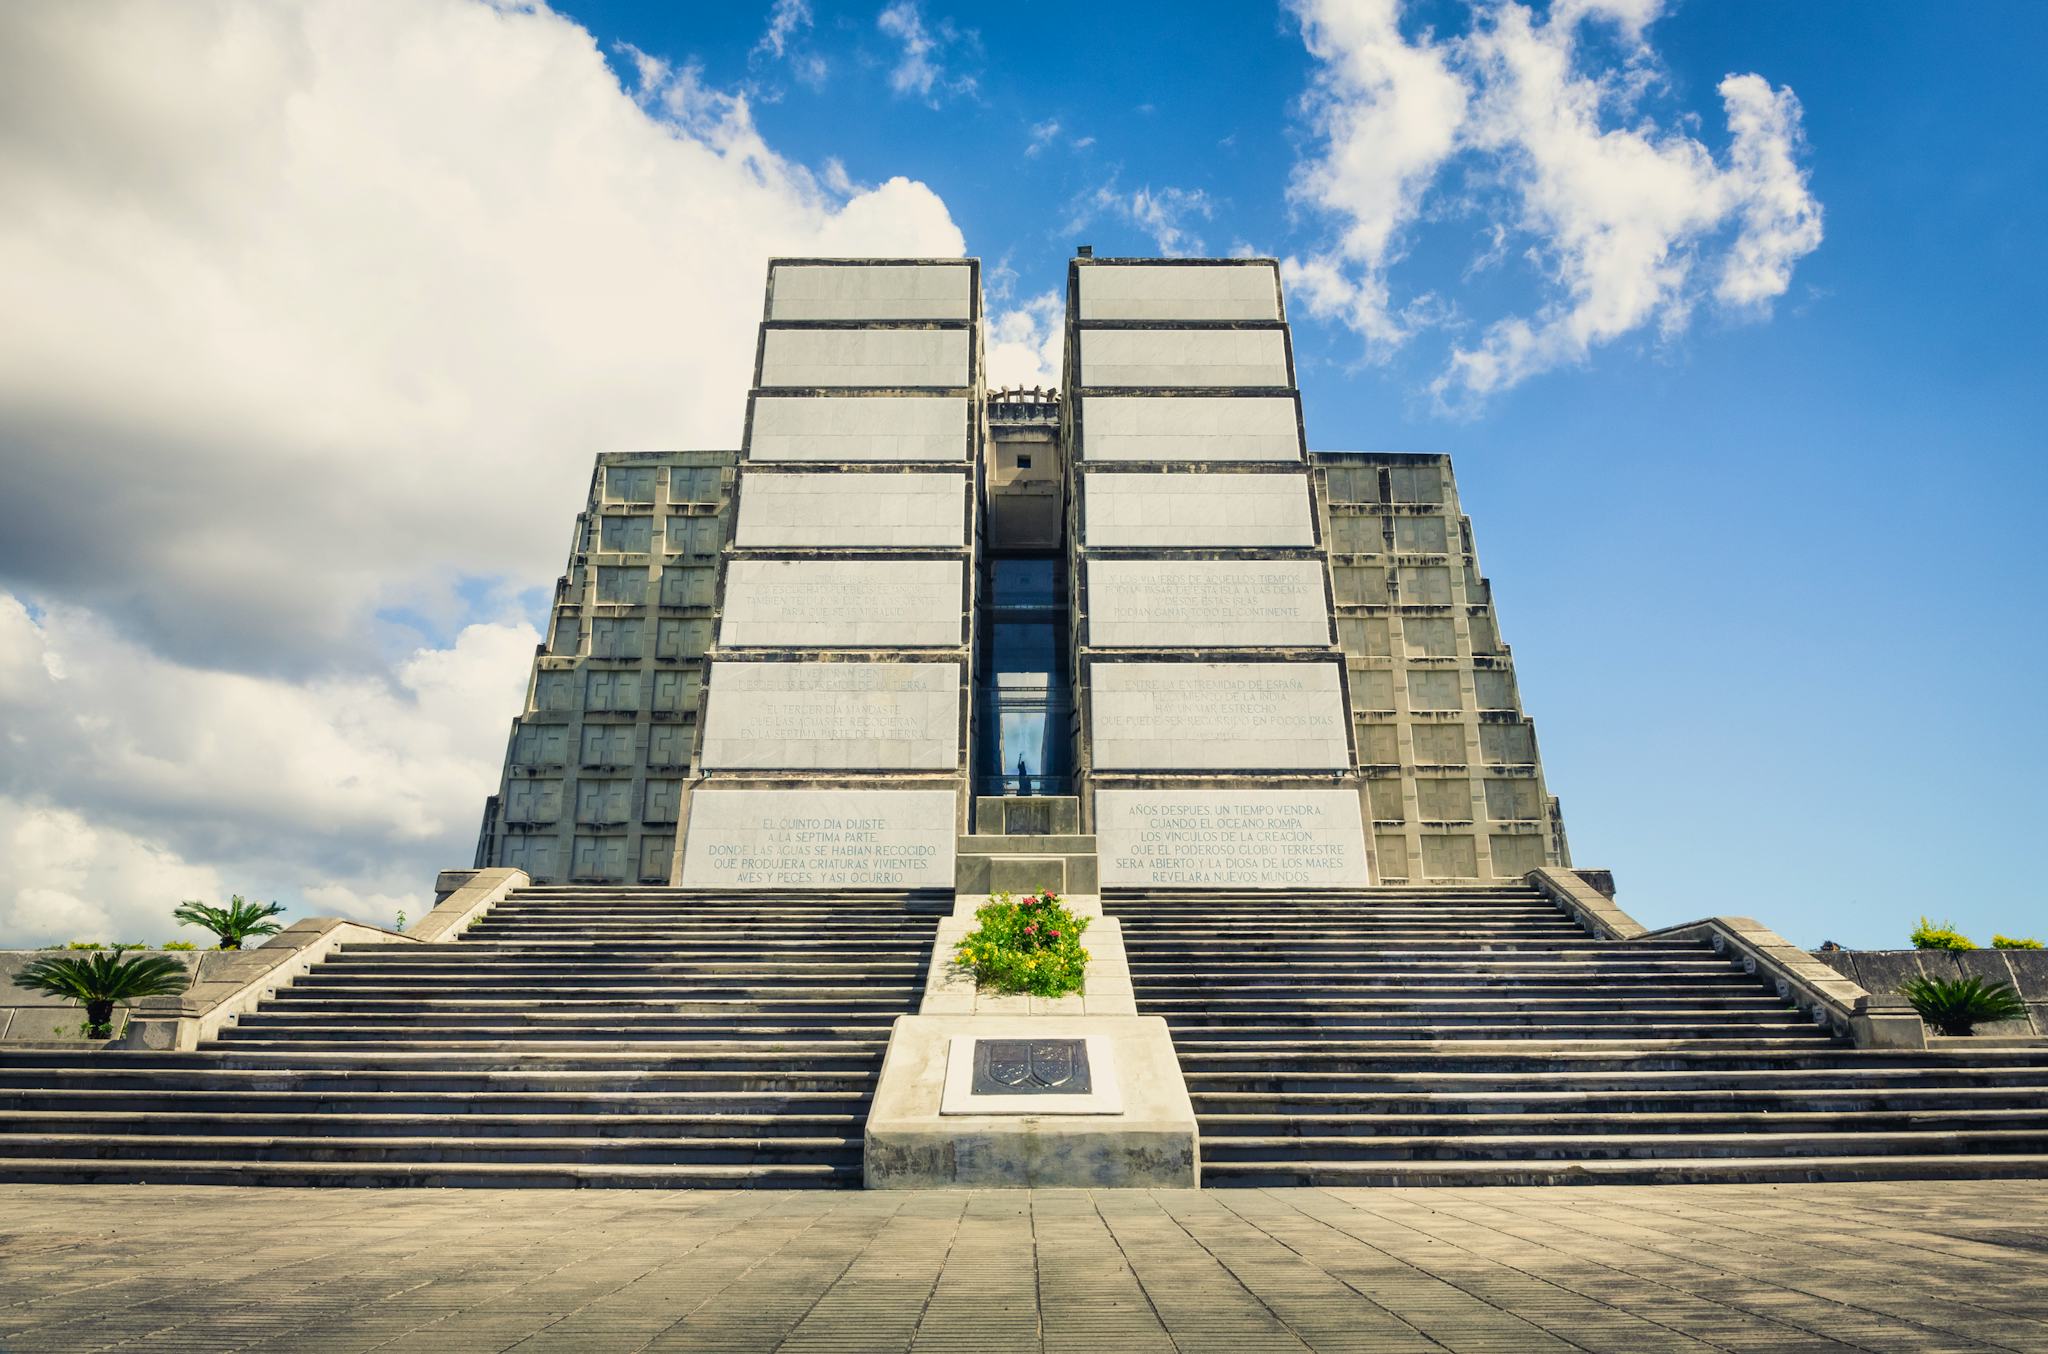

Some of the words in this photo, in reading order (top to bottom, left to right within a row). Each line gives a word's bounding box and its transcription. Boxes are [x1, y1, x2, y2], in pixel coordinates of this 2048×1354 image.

[1120, 575, 1138, 584] LOS
[1189, 575, 1201, 584] DE
[1259, 575, 1301, 584] TIEMPOS
[1254, 586, 1270, 594] LAS
[1274, 586, 1308, 594] DEMAS
[1165, 596, 1197, 606] DESDE
[1190, 608, 1219, 616] TODO
[1222, 608, 1234, 616] EL
[1237, 608, 1300, 616] CONTINENTE
[893, 680, 927, 690] TIERRA
[1125, 680, 1159, 690] ENTRE
[1178, 680, 1245, 690] EXTREMIDAD
[1248, 680, 1262, 690] DE
[1266, 678, 1304, 690] ESPAÑA
[1244, 692, 1256, 702] LA
[768, 704, 778, 714] EL
[1101, 716, 1124, 726] QUE
[1252, 716, 1266, 726] EN
[1270, 716, 1306, 726] POCOS
[1310, 716, 1334, 726] DIAS
[758, 729, 770, 739] LA
[856, 729, 870, 739] DE
[1129, 804, 1158, 816] AÑOS
[1215, 806, 1230, 816] UN
[1234, 806, 1274, 816] TIEMPO
[762, 818, 775, 830] EL
[824, 818, 842, 830] DIA
[846, 818, 886, 830] DIJISTE
[1150, 818, 1197, 829] CUANDO
[1200, 818, 1214, 829] EL
[1217, 818, 1264, 829] OCEANO
[1268, 818, 1302, 829] ROMPA
[768, 832, 774, 842] A
[778, 832, 791, 842] LA
[796, 832, 840, 842] SEPTIMA
[1140, 832, 1161, 842] LOS
[1164, 832, 1218, 842] VINCULOS
[1221, 832, 1236, 842] DE
[1240, 832, 1254, 842] LA
[708, 845, 750, 856] DONDE
[753, 845, 773, 856] LAS
[777, 845, 810, 856] AGUAS
[814, 845, 828, 856] SE
[832, 845, 872, 856] HABIAN
[1130, 845, 1154, 856] QUE
[1158, 845, 1171, 856] EL
[1175, 845, 1235, 856] PODEROSO
[1239, 845, 1278, 856] GLOBO
[1280, 845, 1344, 856] TERRESTRE
[714, 858, 738, 870] QUE
[742, 858, 805, 870] PRODUJERA
[809, 858, 868, 870] CRIATURAS
[1116, 858, 1144, 869] SERA
[1149, 858, 1195, 869] ABIERTO
[1198, 858, 1204, 869] Y
[1208, 858, 1222, 869] LA
[1226, 858, 1258, 869] DIOSA
[1262, 858, 1278, 869] DE
[1282, 858, 1302, 869] LOS
[1306, 858, 1344, 869] MARES
[737, 872, 762, 883] AVES
[767, 872, 774, 883] Y
[820, 872, 827, 883] Y
[830, 872, 846, 883] ASI
[1152, 872, 1210, 882] REVELARA
[1214, 872, 1258, 882] NUEVOS
